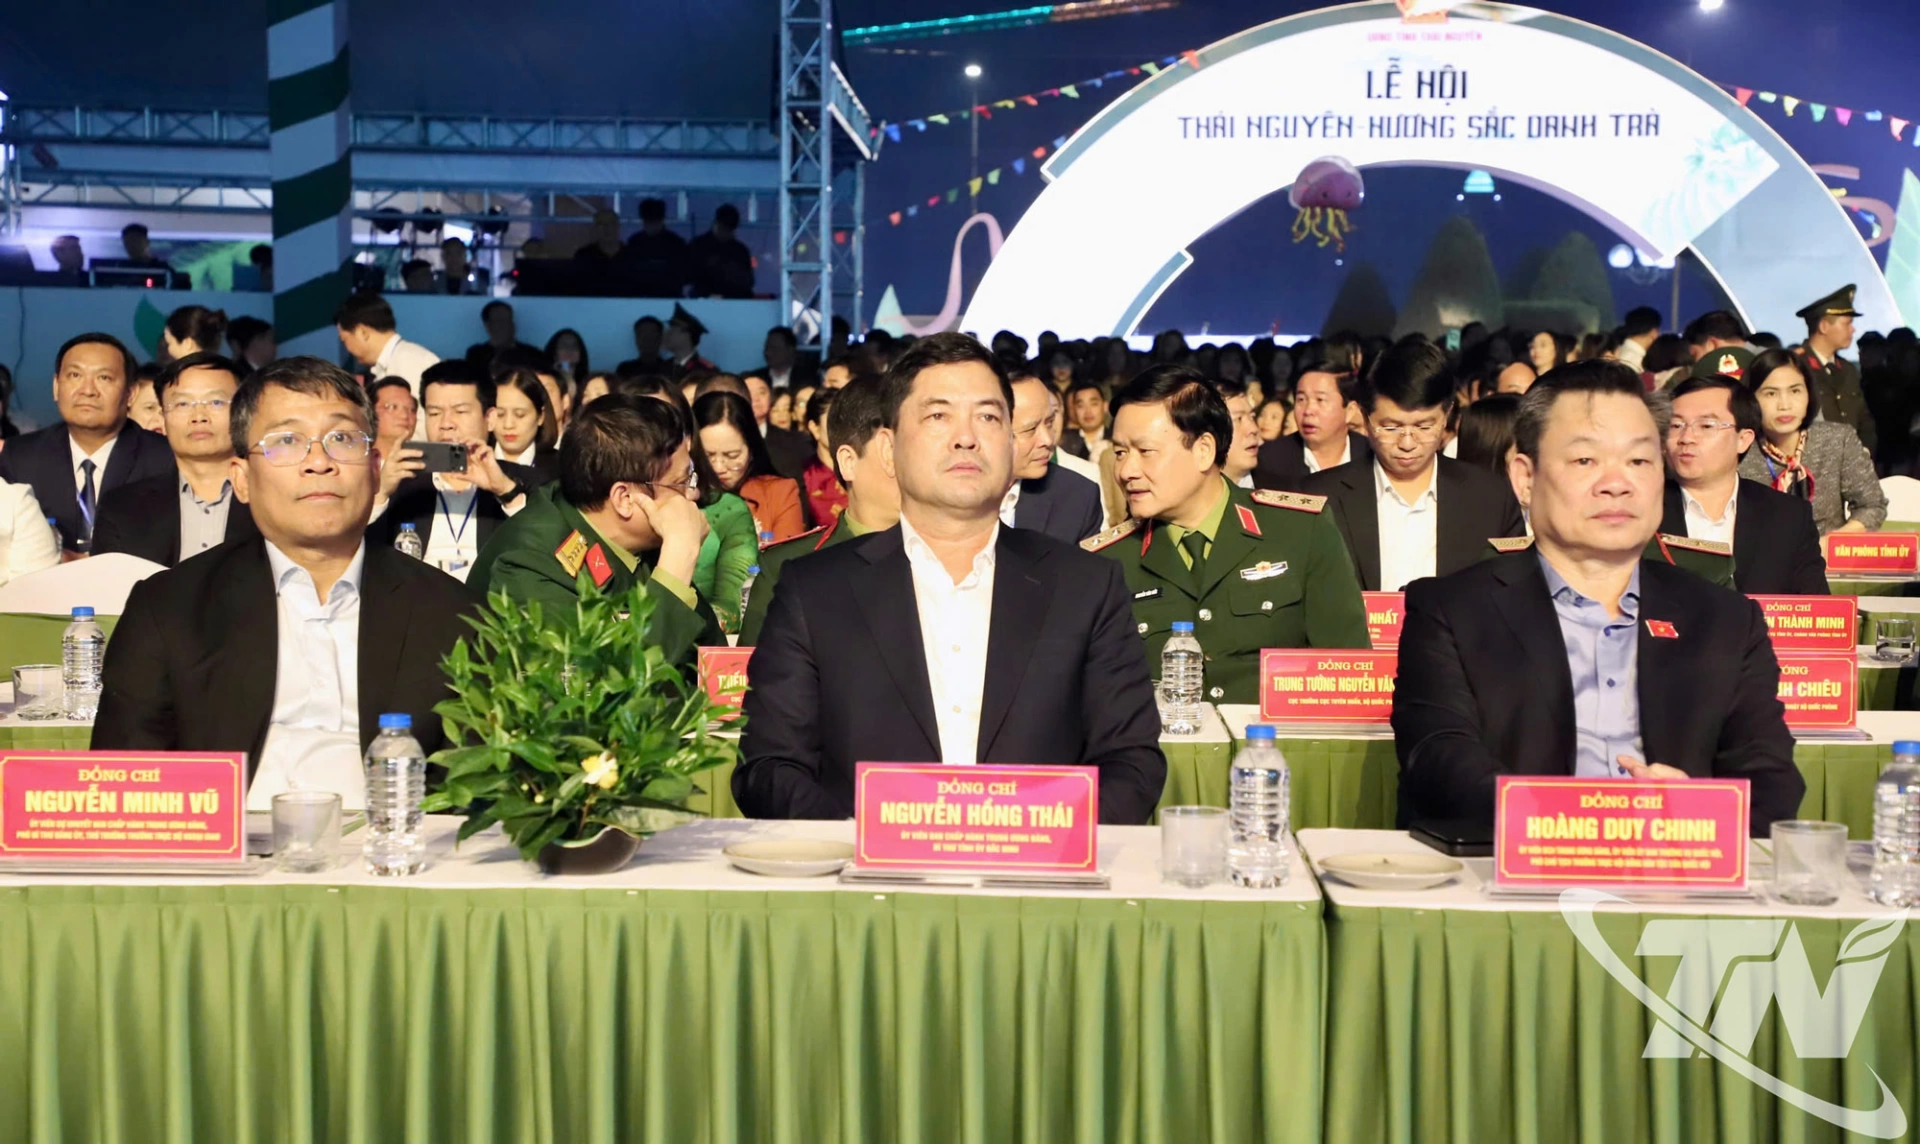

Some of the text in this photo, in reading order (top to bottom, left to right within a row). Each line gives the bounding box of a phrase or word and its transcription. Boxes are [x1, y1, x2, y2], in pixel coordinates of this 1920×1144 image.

[1367, 57, 1467, 106] LỄ HỘI
[1178, 110, 1235, 139] THÁI
[1467, 106, 1515, 138] SẮC
[1609, 107, 1660, 137] TRÀ
[1369, 608, 1398, 625] NHẤT
[1777, 614, 1813, 629] THÀNH
[1815, 617, 1845, 629] MINH
[1317, 659, 1374, 670] ĐỒNG CHÍ
[1273, 676, 1304, 692] TRUNG
[1306, 674, 1336, 692] TƯỚNG
[1338, 671, 1375, 692] NGUYỄN
[78, 765, 161, 782] ĐỒNG CHÍ
[937, 777, 1017, 796] ĐỒNG CHÍ
[25, 784, 219, 814] NGUYỄN MINH VŨ
[1580, 791, 1663, 809] ĐỒNG CHÍ
[880, 796, 1074, 828] NGUYỄN HỒNG THÁI
[1526, 812, 1716, 842] HOÀNG DUY CHINH
